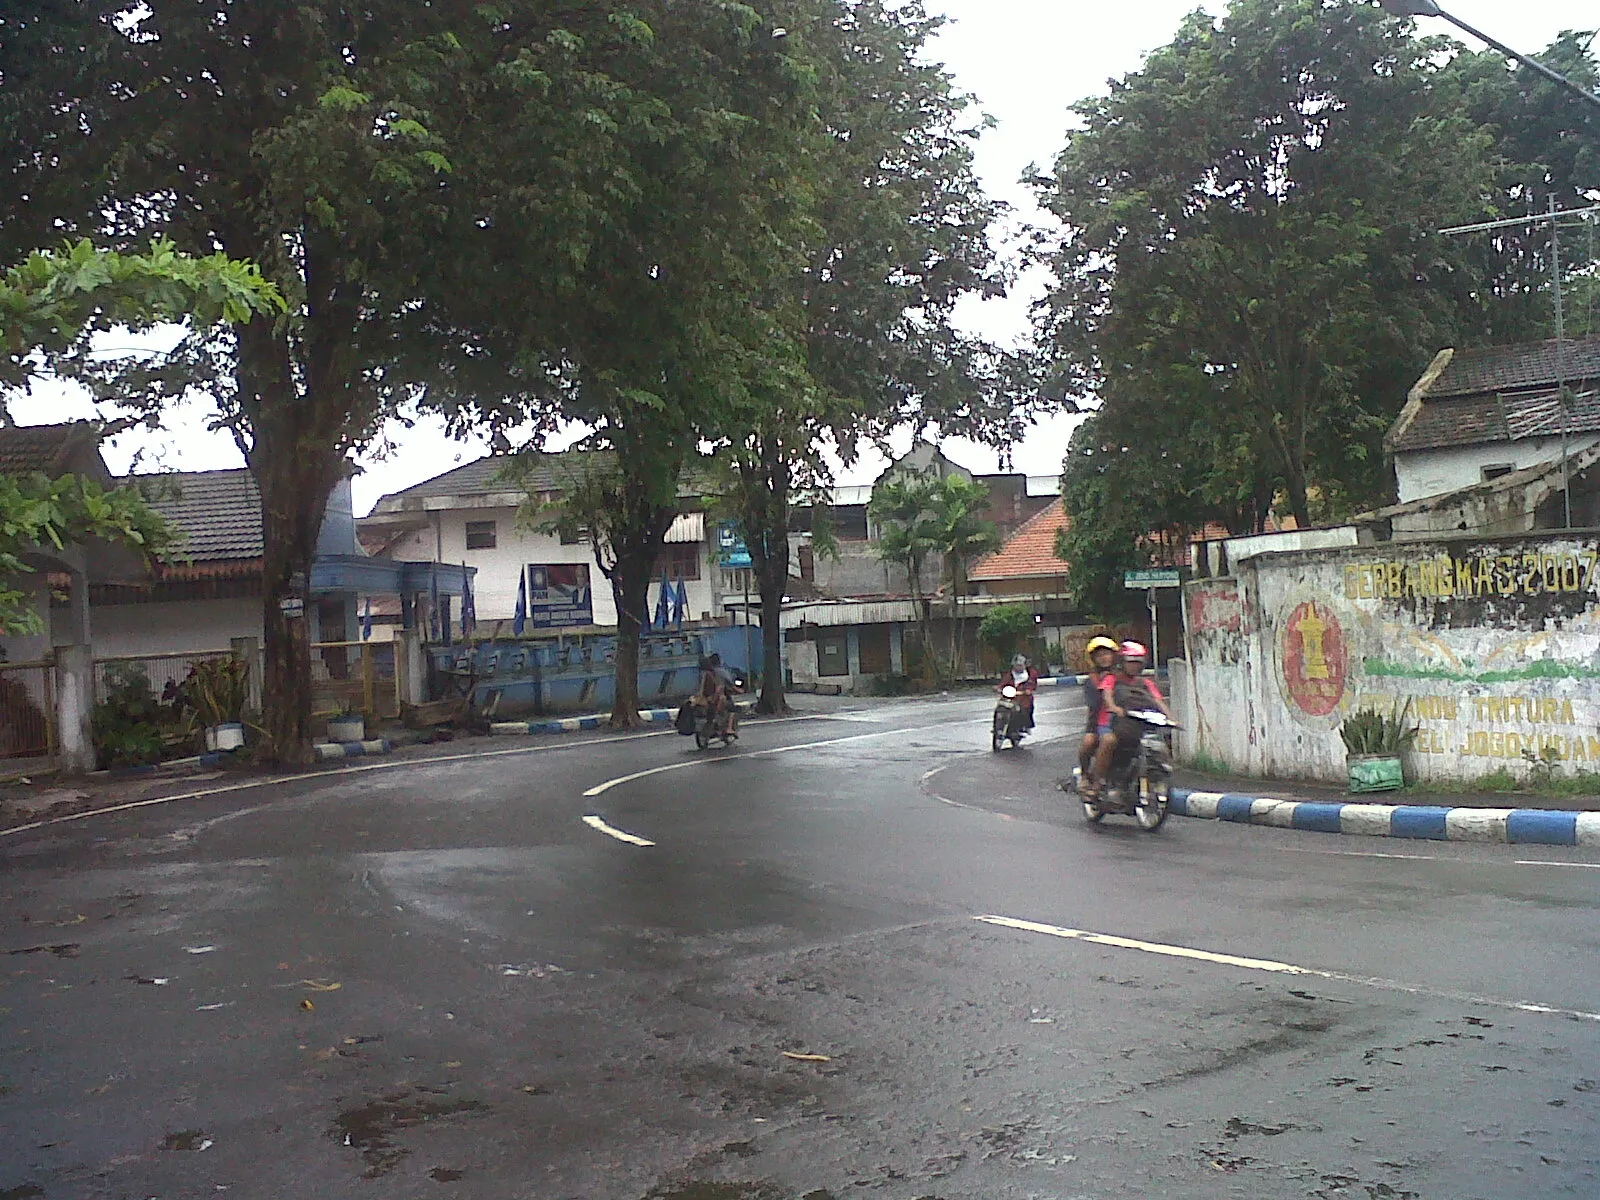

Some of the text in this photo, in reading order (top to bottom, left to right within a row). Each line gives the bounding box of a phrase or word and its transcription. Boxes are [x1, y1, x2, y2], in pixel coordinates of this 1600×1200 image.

[1344, 550, 1599, 600] GERBANGMAS 2007
[1472, 696, 1577, 725] TRITURA
